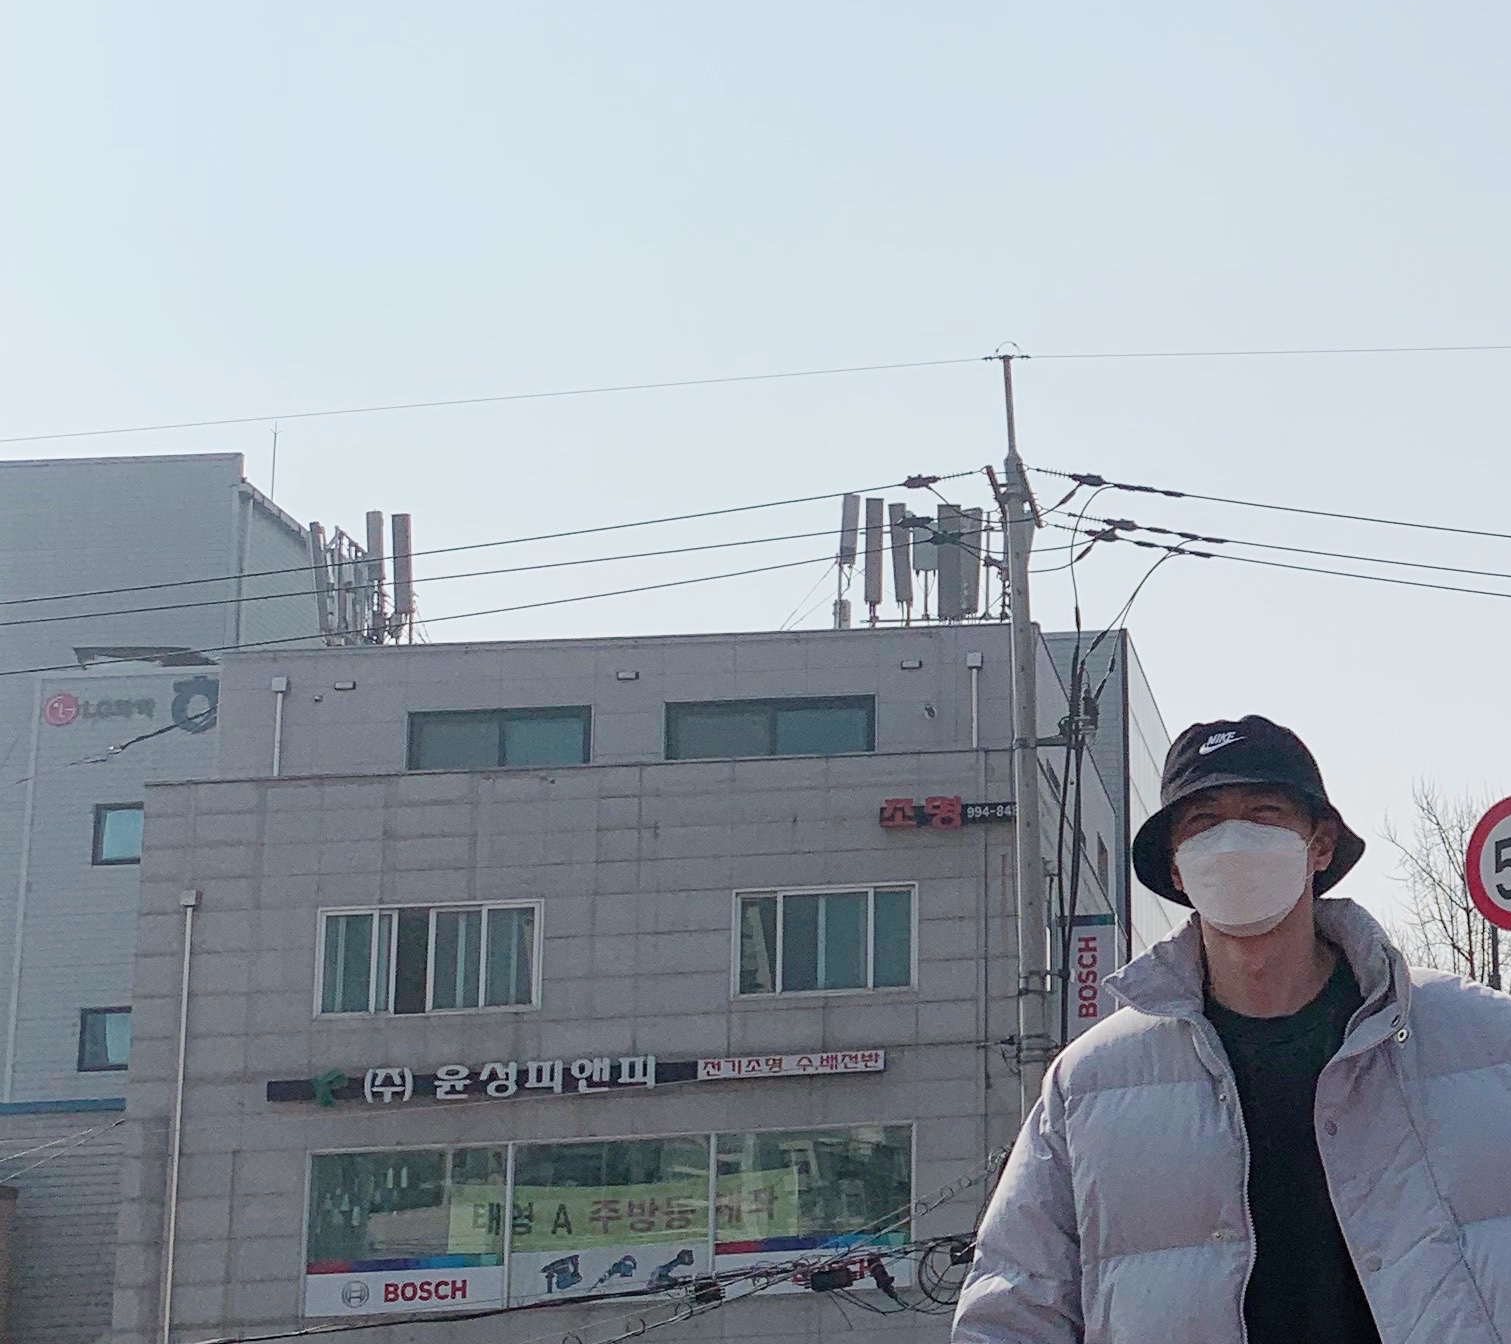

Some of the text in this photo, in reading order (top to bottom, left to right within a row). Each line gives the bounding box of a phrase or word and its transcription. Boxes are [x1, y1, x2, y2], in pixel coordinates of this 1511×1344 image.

[1207, 731, 1237, 746] NIKE
[1077, 935, 1098, 1018] BOSCH
[363, 1054, 657, 1103] (주) 윤성피앤피
[551, 1203, 574, 1236] A
[383, 1278, 468, 1304] BOSCH
